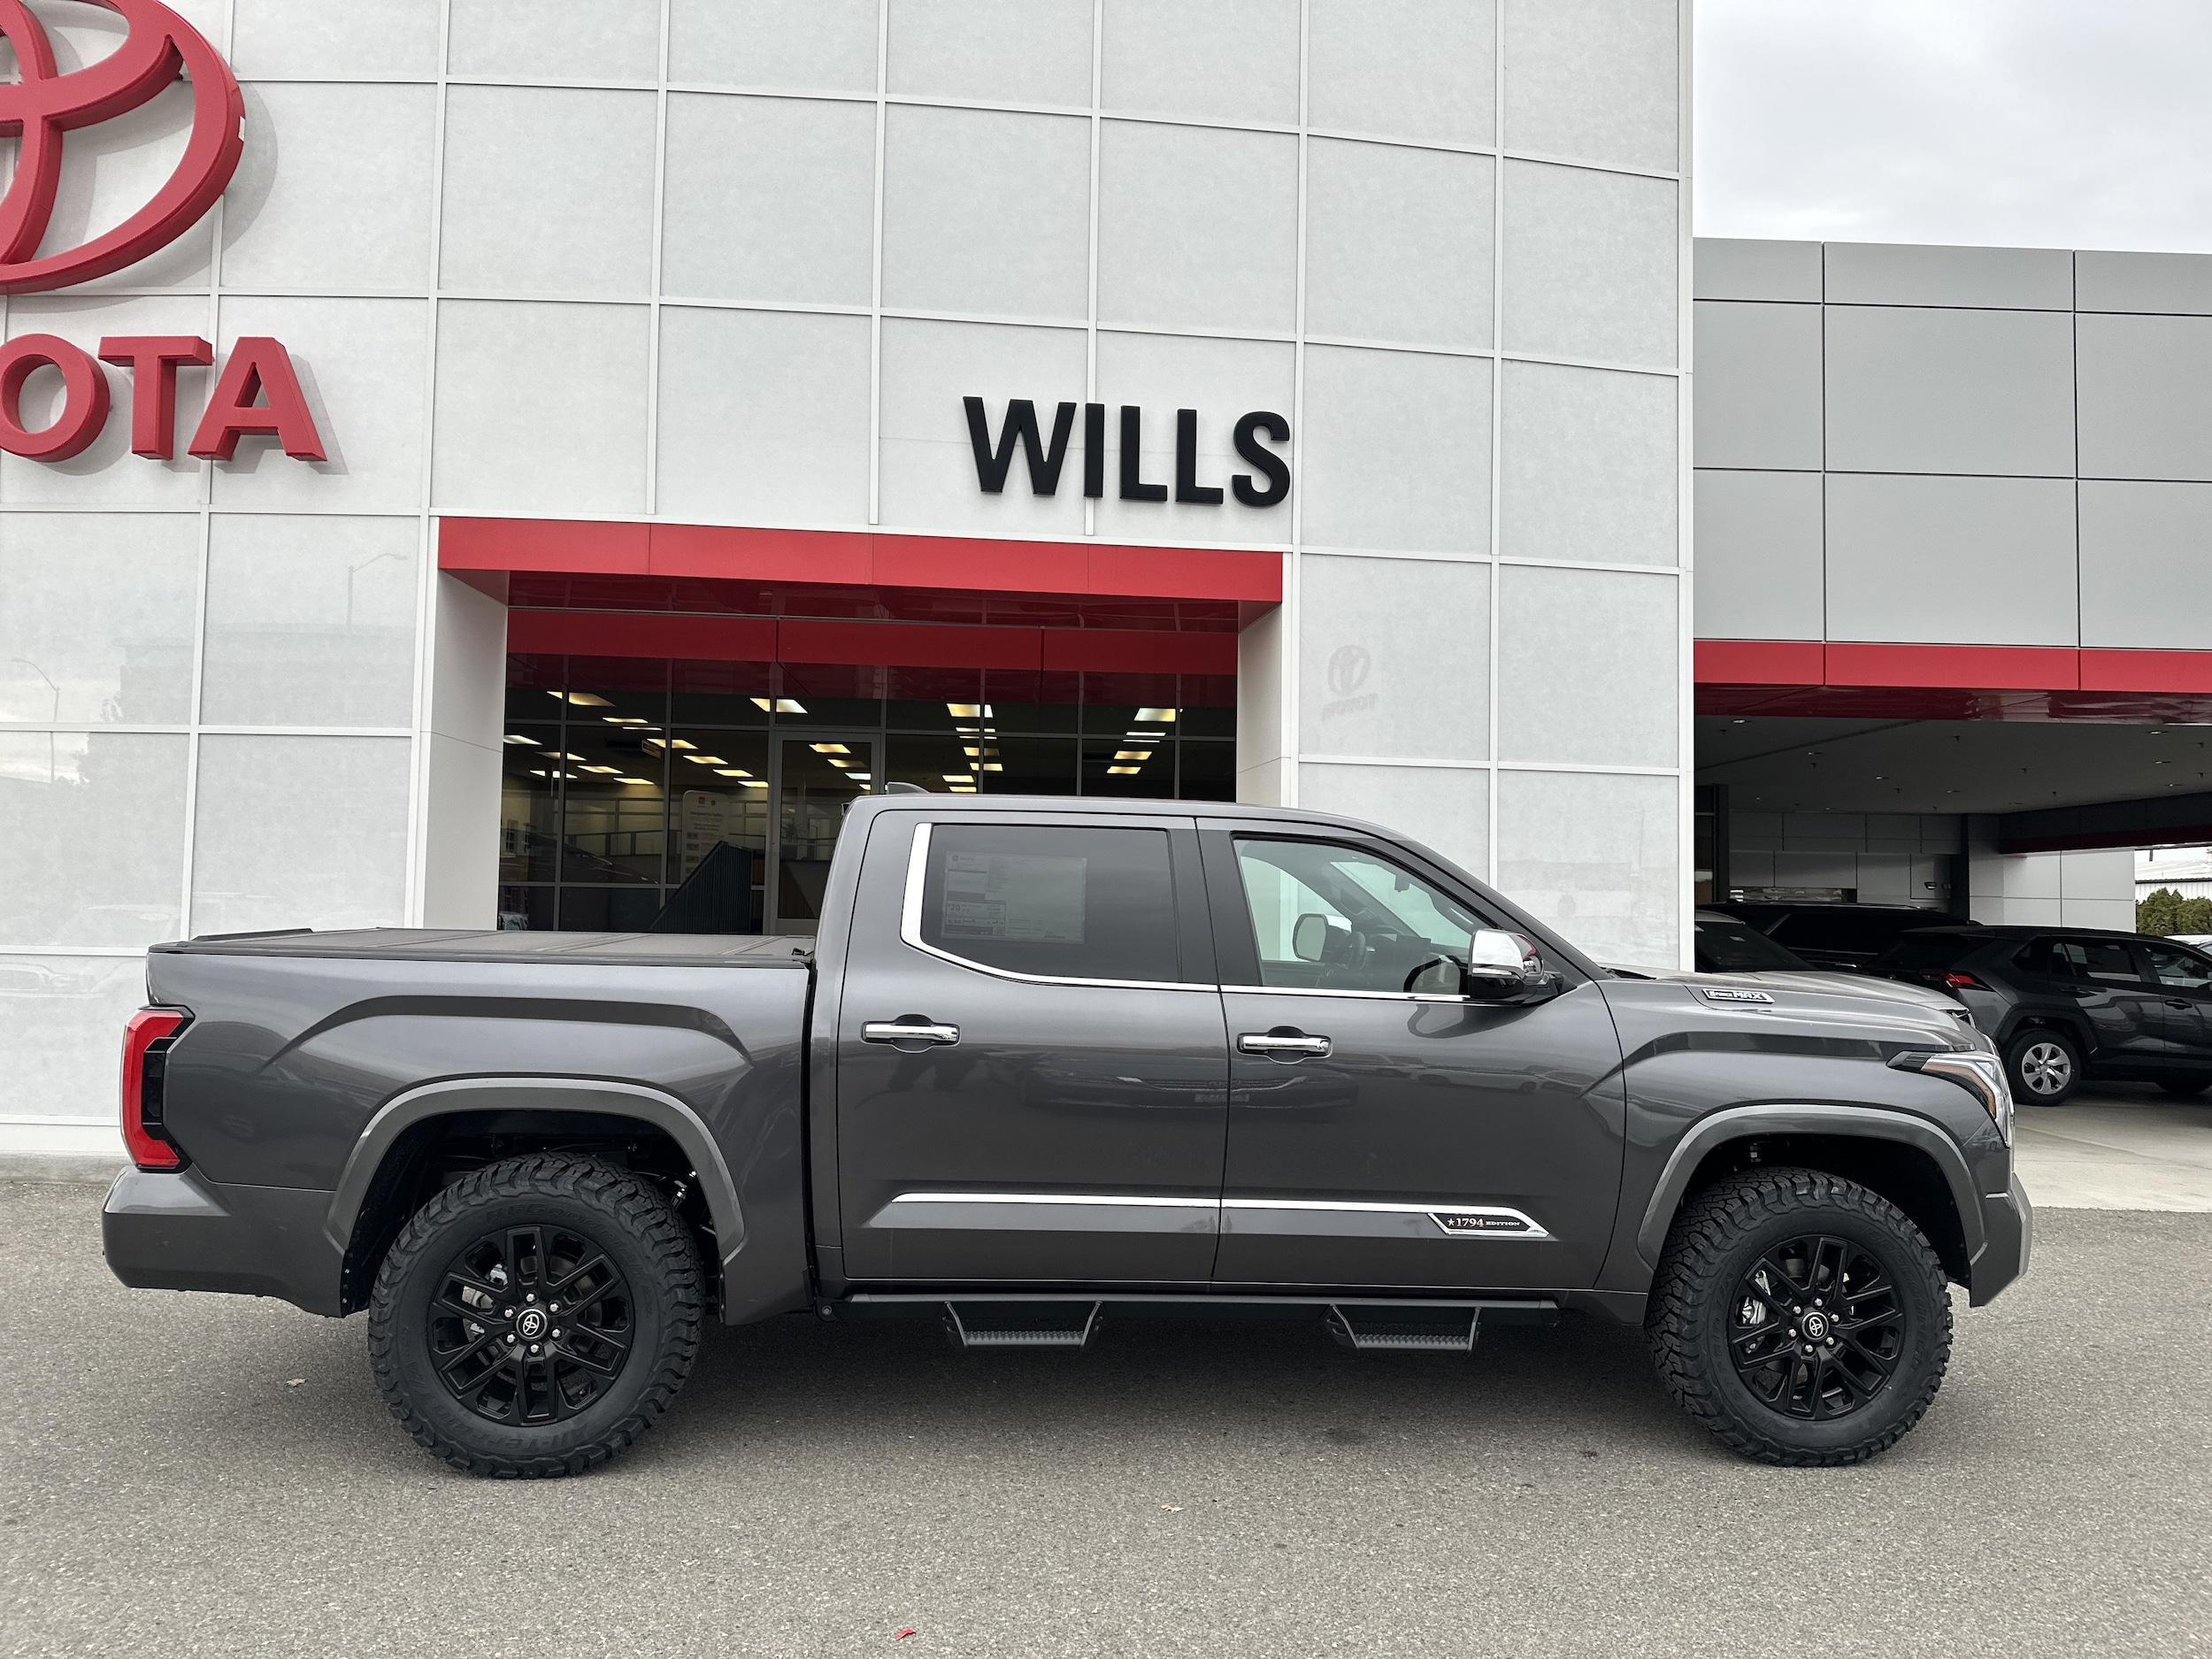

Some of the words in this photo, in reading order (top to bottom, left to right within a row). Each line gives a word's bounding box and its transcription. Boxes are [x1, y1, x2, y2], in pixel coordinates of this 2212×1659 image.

[963, 396, 1291, 507] WILLS
[1733, 991, 1763, 1000] MAX
[486, 1203, 647, 1280] BFGoodrich
[1456, 1217, 1484, 1228] 1794
